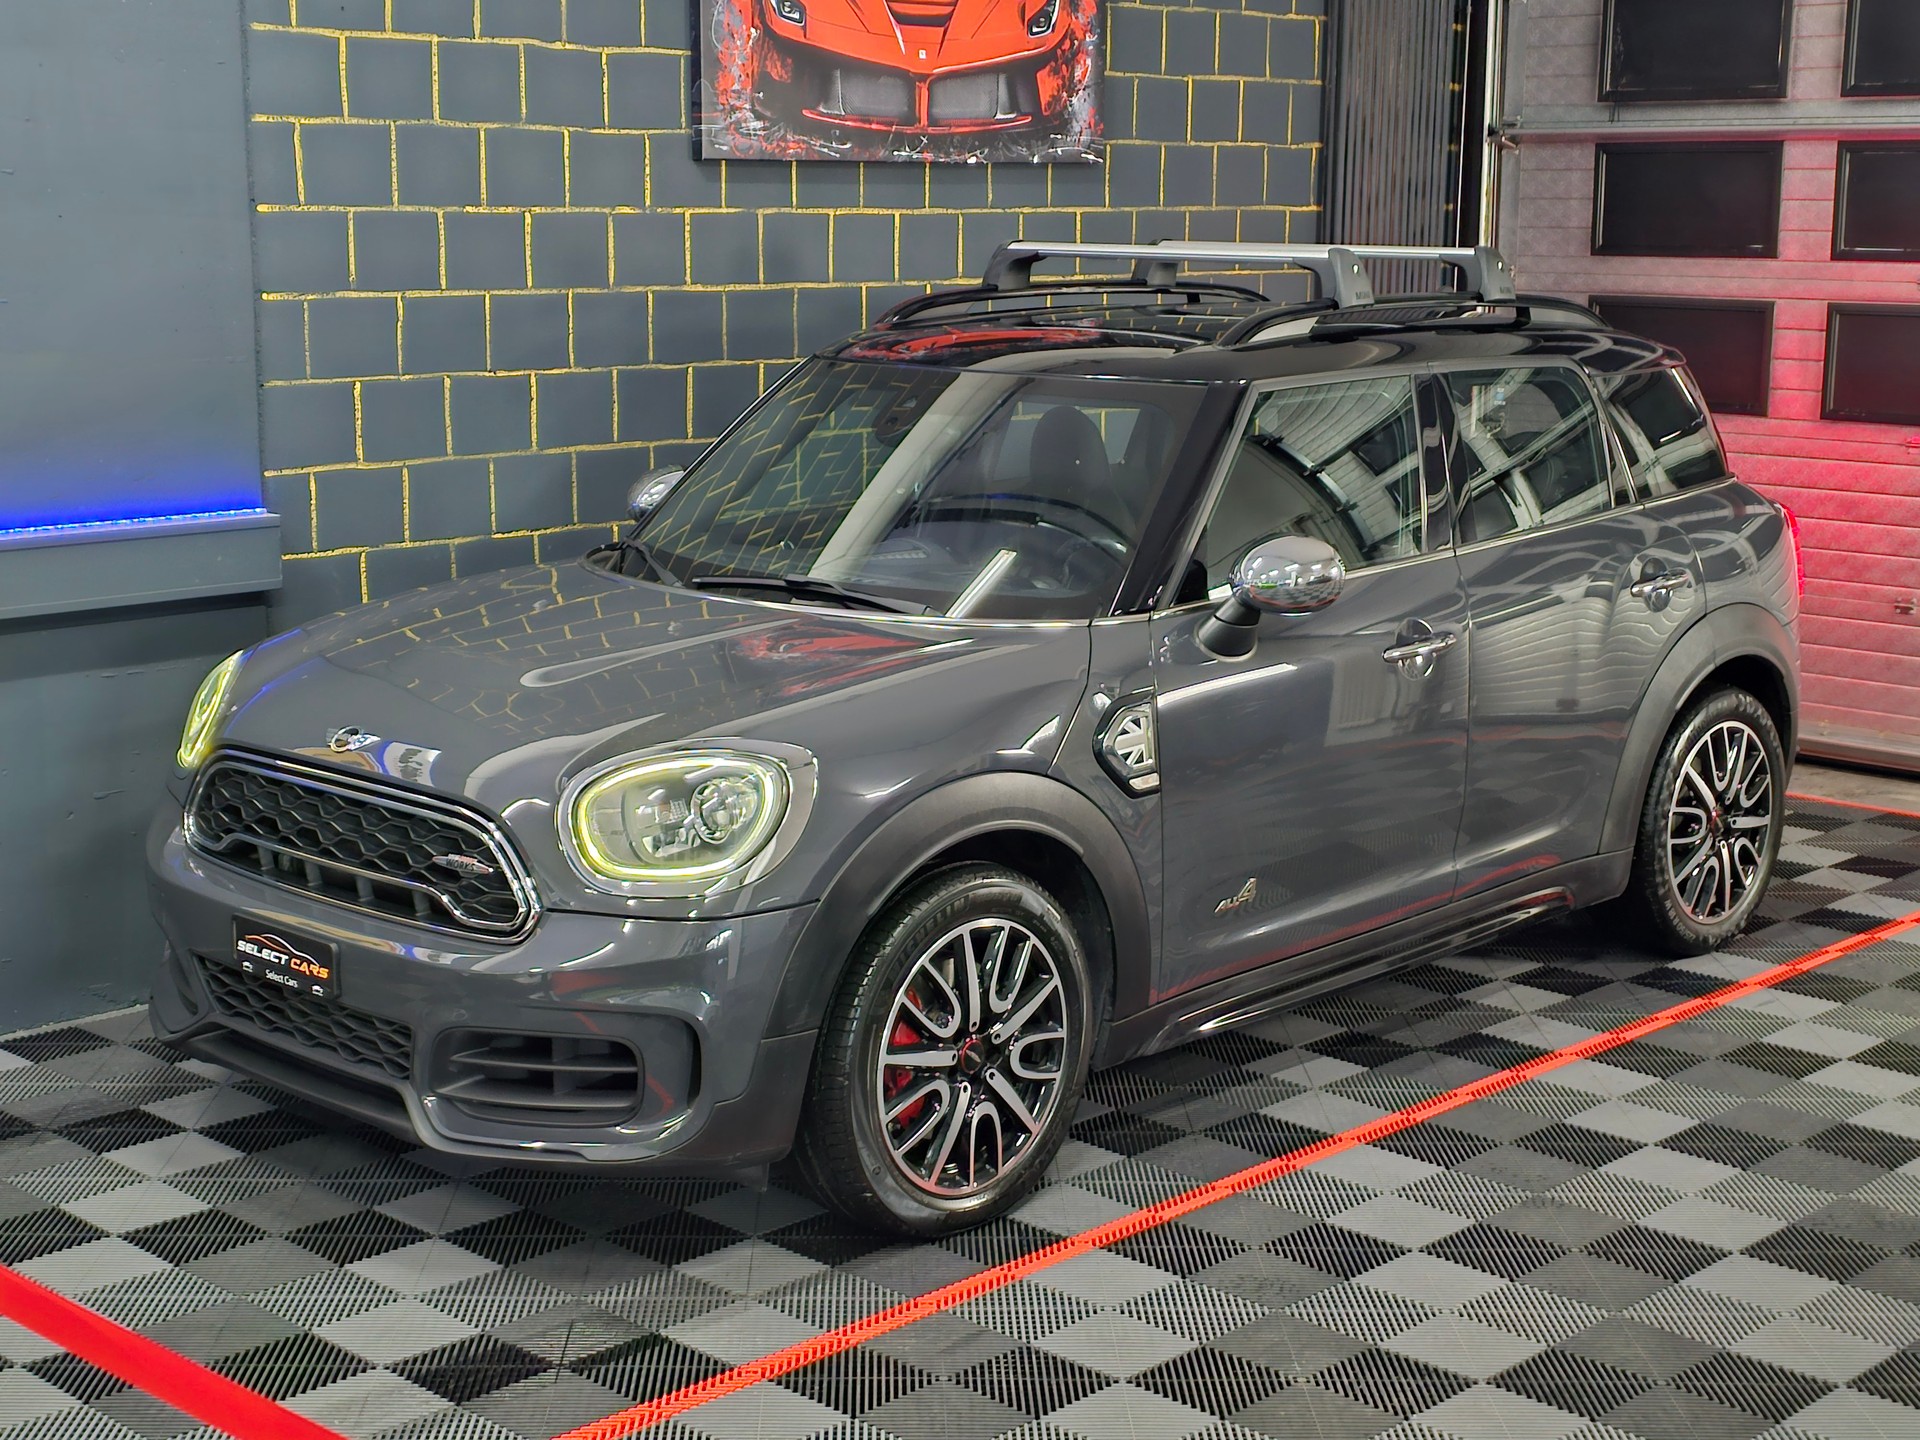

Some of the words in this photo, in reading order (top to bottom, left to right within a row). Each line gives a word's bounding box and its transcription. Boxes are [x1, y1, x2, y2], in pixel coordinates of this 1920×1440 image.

[446, 858, 475, 872] WORKS
[236, 939, 289, 965] SELECT
[290, 957, 330, 979] CARS
[265, 969, 284, 984] Select
[284, 975, 299, 988] Cars
